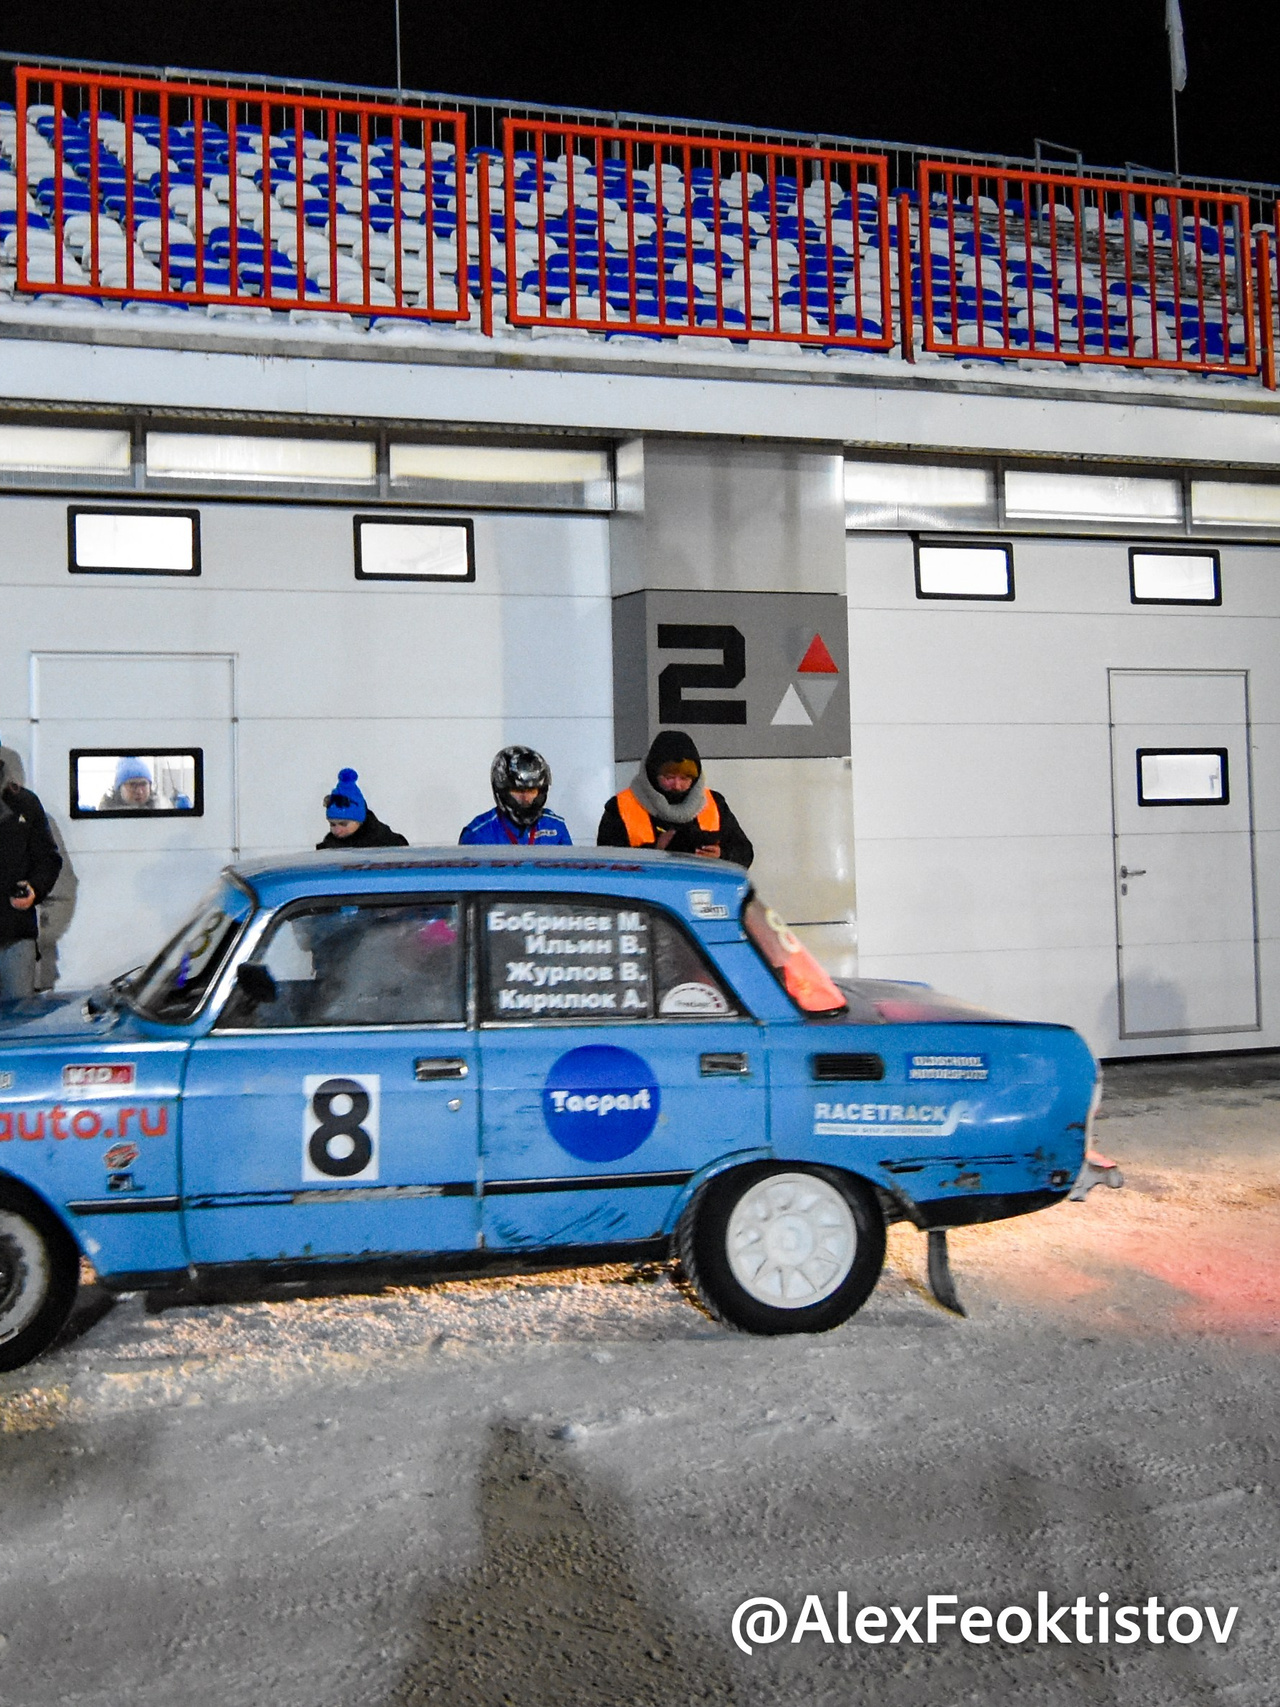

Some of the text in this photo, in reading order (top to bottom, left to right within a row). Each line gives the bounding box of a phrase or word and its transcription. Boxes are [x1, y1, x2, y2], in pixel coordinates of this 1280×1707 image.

[658, 624, 746, 725] 2
[488, 911, 647, 933] Бобринев М.
[525, 934, 647, 954] Ильин В.
[506, 962, 647, 986] Журлов В.
[498, 989, 647, 1012] Кирилюк А.
[814, 1103, 947, 1122] RACETRACK
[309, 1078, 372, 1176] 8
